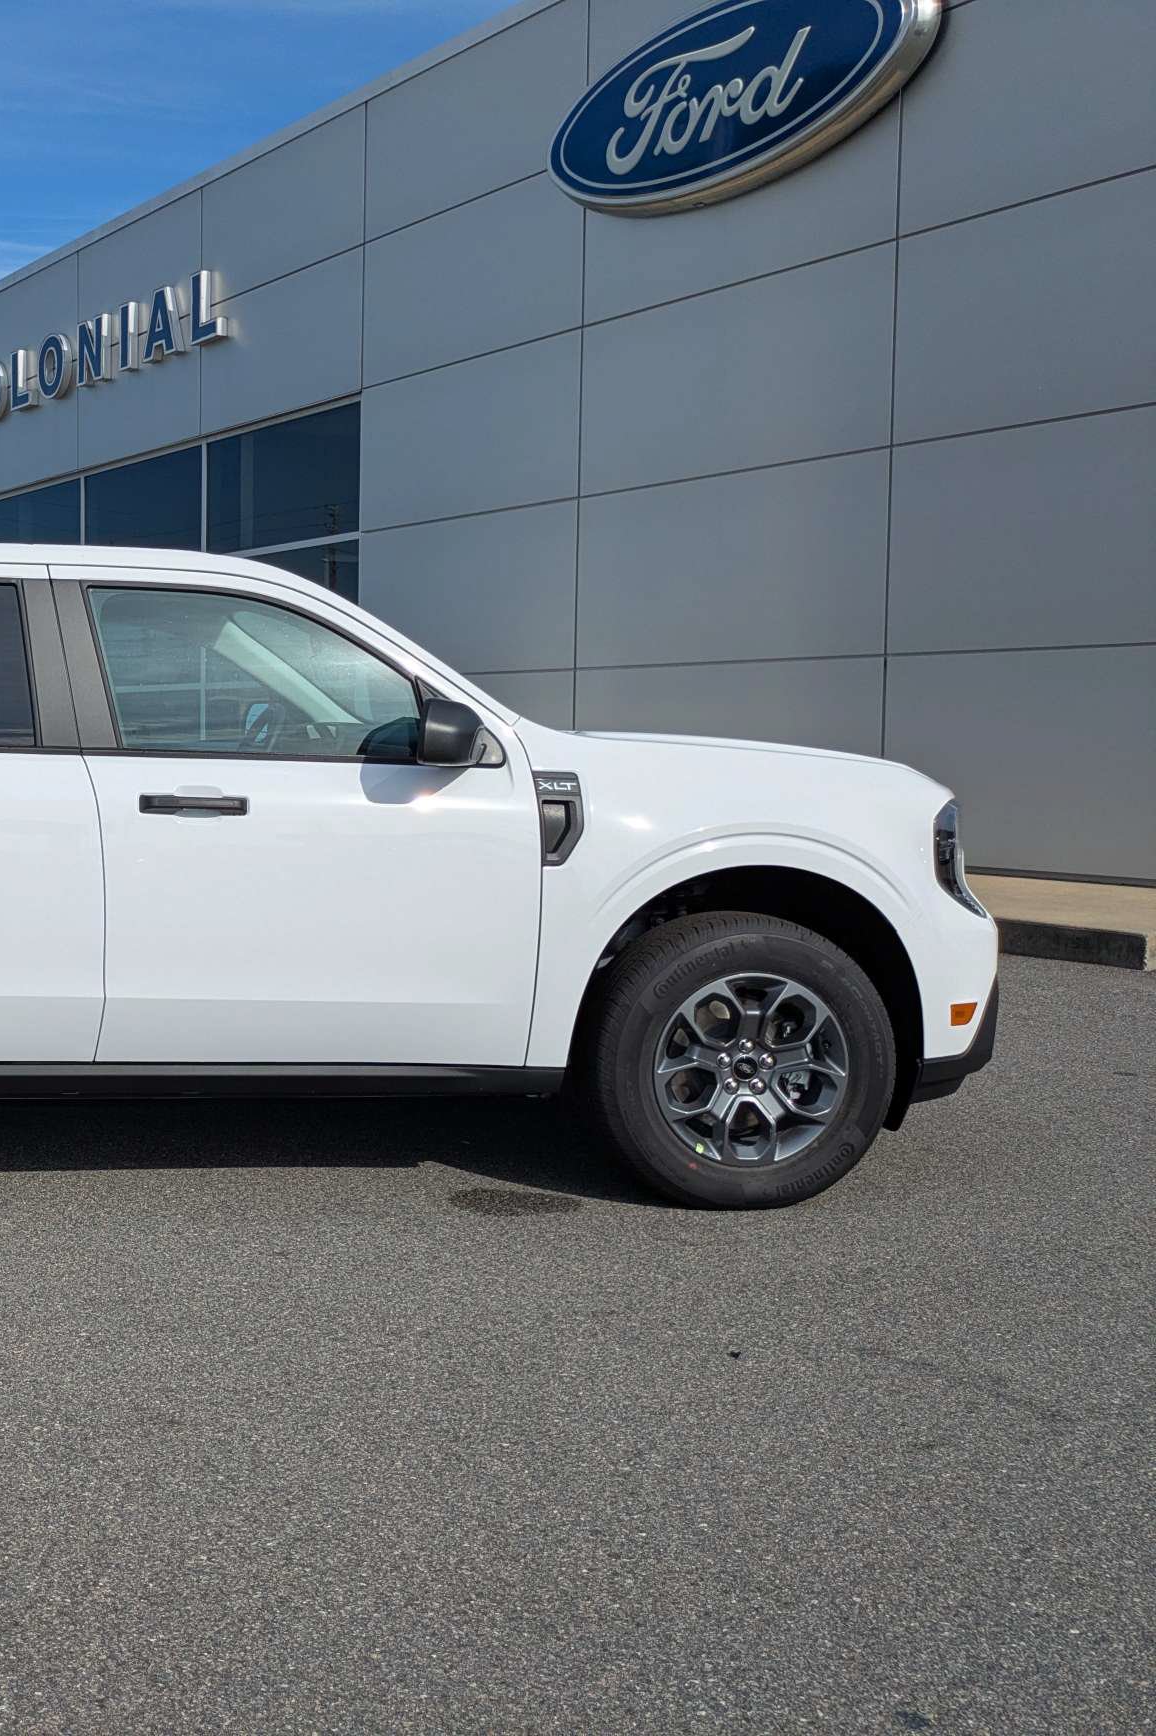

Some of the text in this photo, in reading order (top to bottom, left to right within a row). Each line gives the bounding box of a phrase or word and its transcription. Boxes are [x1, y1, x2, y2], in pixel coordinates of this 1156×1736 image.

[606, 26, 811, 175] Ford
[538, 781, 577, 791] XLT
[652, 942, 735, 1000] Continental
